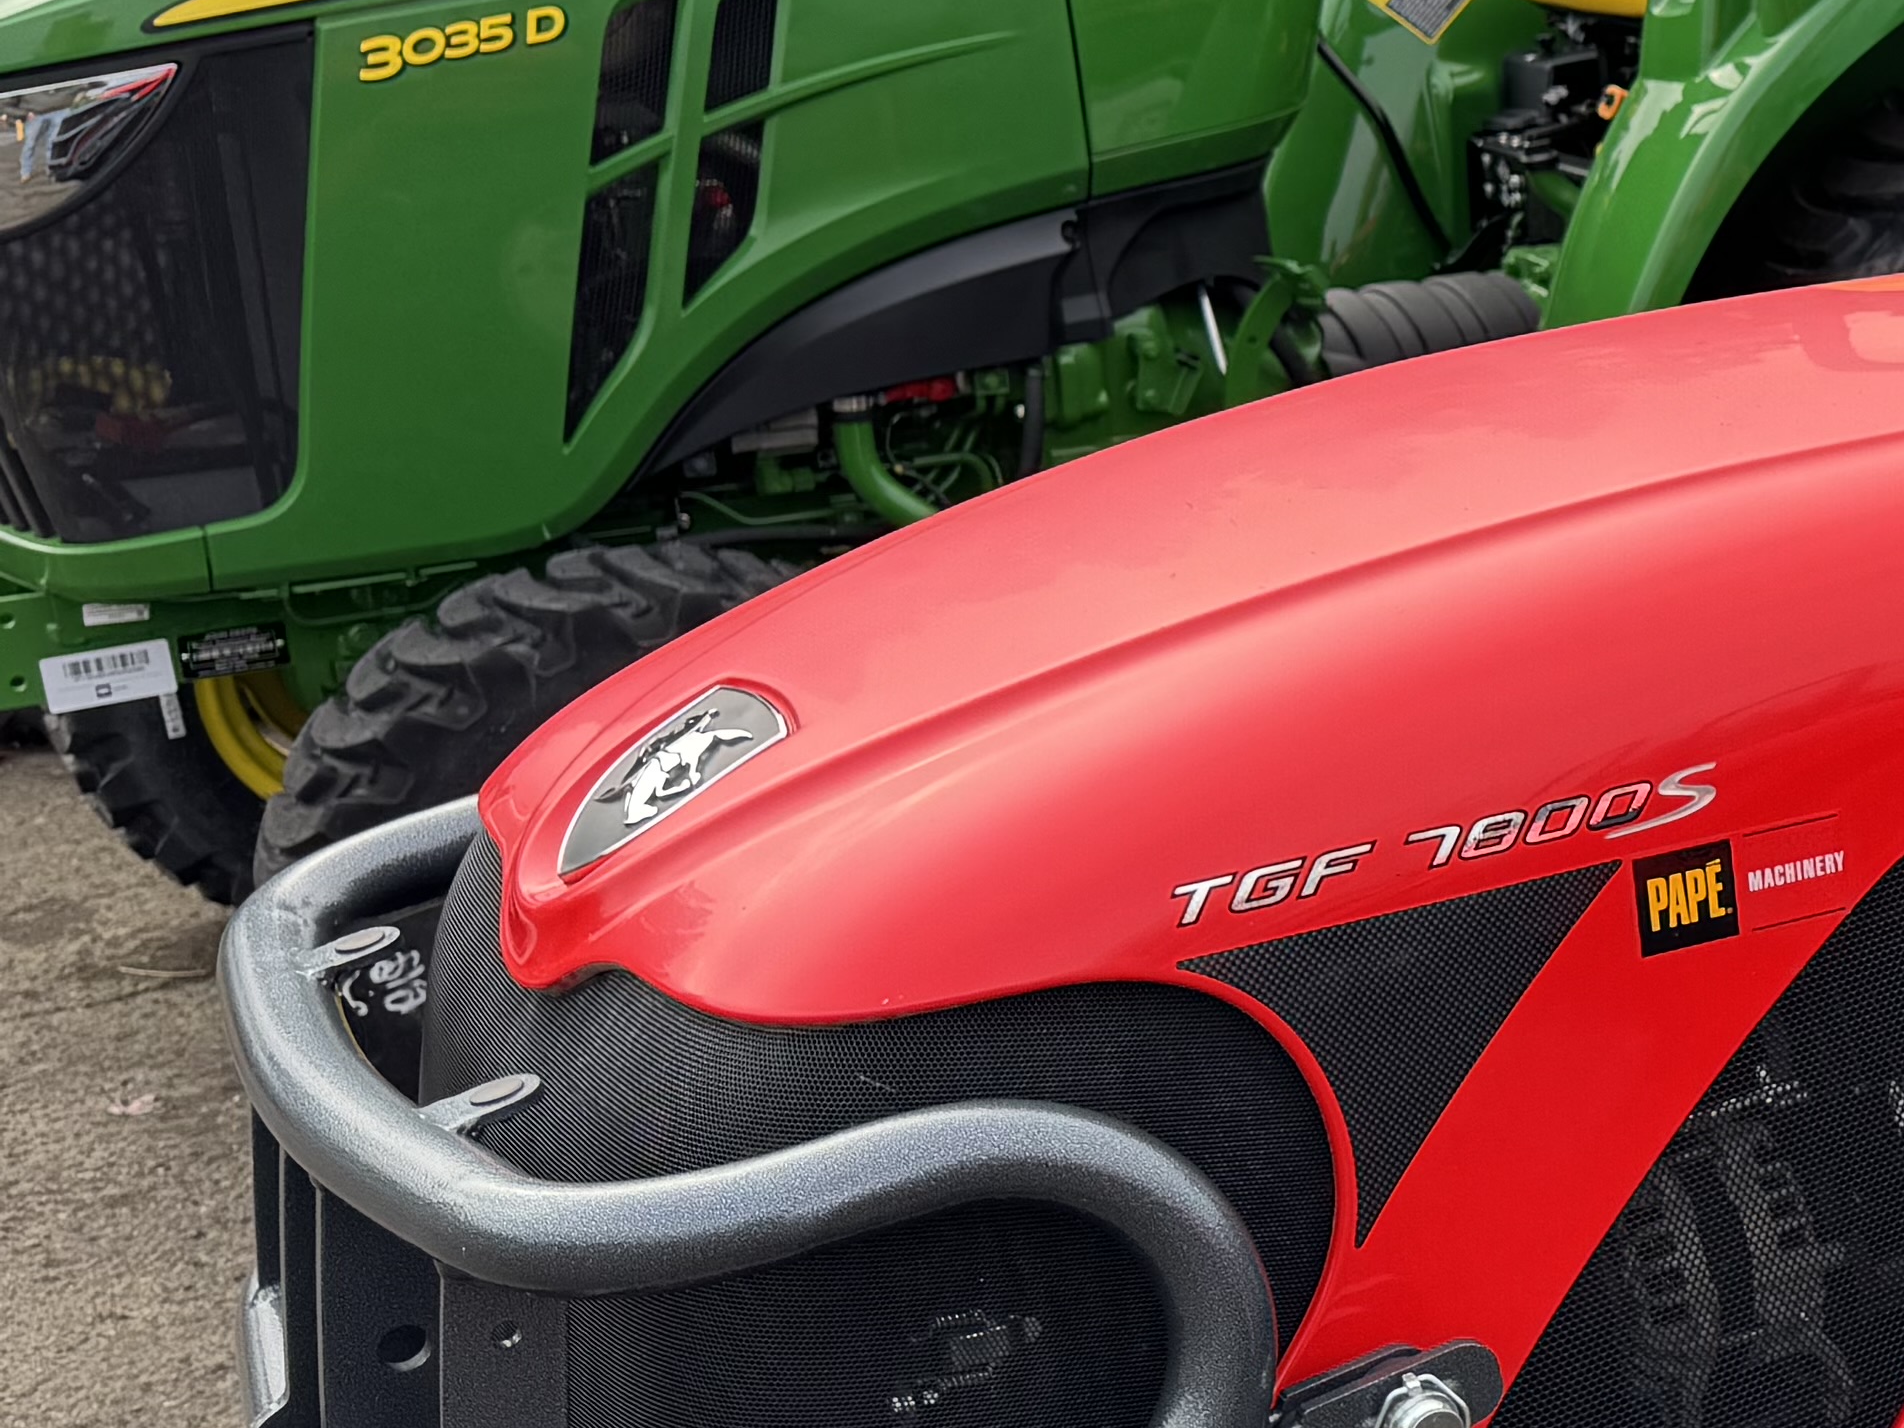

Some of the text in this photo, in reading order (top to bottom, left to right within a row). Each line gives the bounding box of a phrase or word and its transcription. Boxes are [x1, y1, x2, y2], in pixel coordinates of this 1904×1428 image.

[358, 4, 567, 83] 3035 D
[1171, 761, 1718, 928] TGF 7800S
[1746, 850, 1848, 894] MACHINERY
